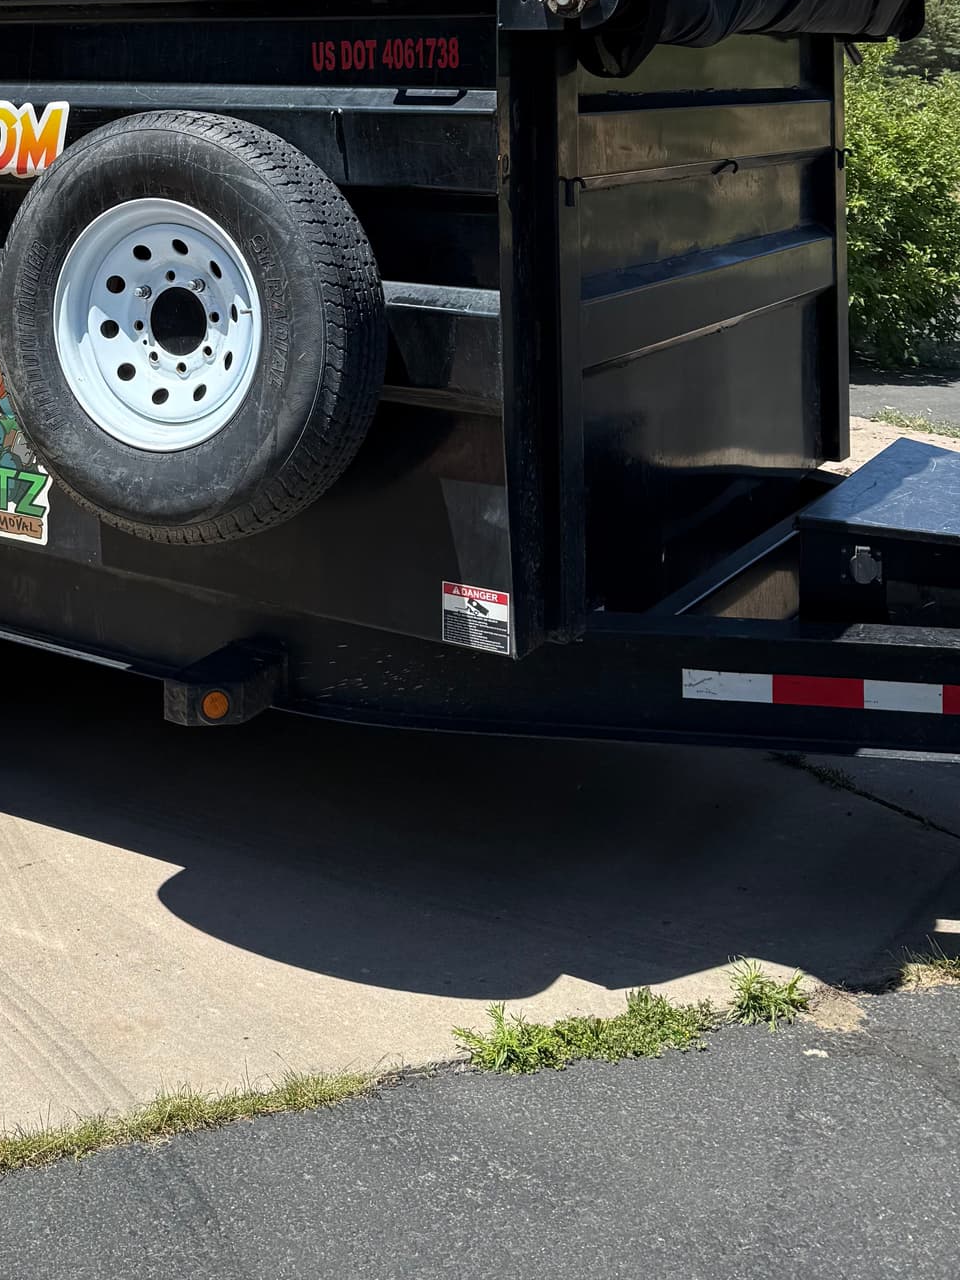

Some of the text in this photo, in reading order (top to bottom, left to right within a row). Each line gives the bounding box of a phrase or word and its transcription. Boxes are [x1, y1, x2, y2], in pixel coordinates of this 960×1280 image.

[311, 37, 460, 72] US DOT 4061738
[17, 240, 49, 327] HAULER
[461, 588, 499, 602] DANGER
